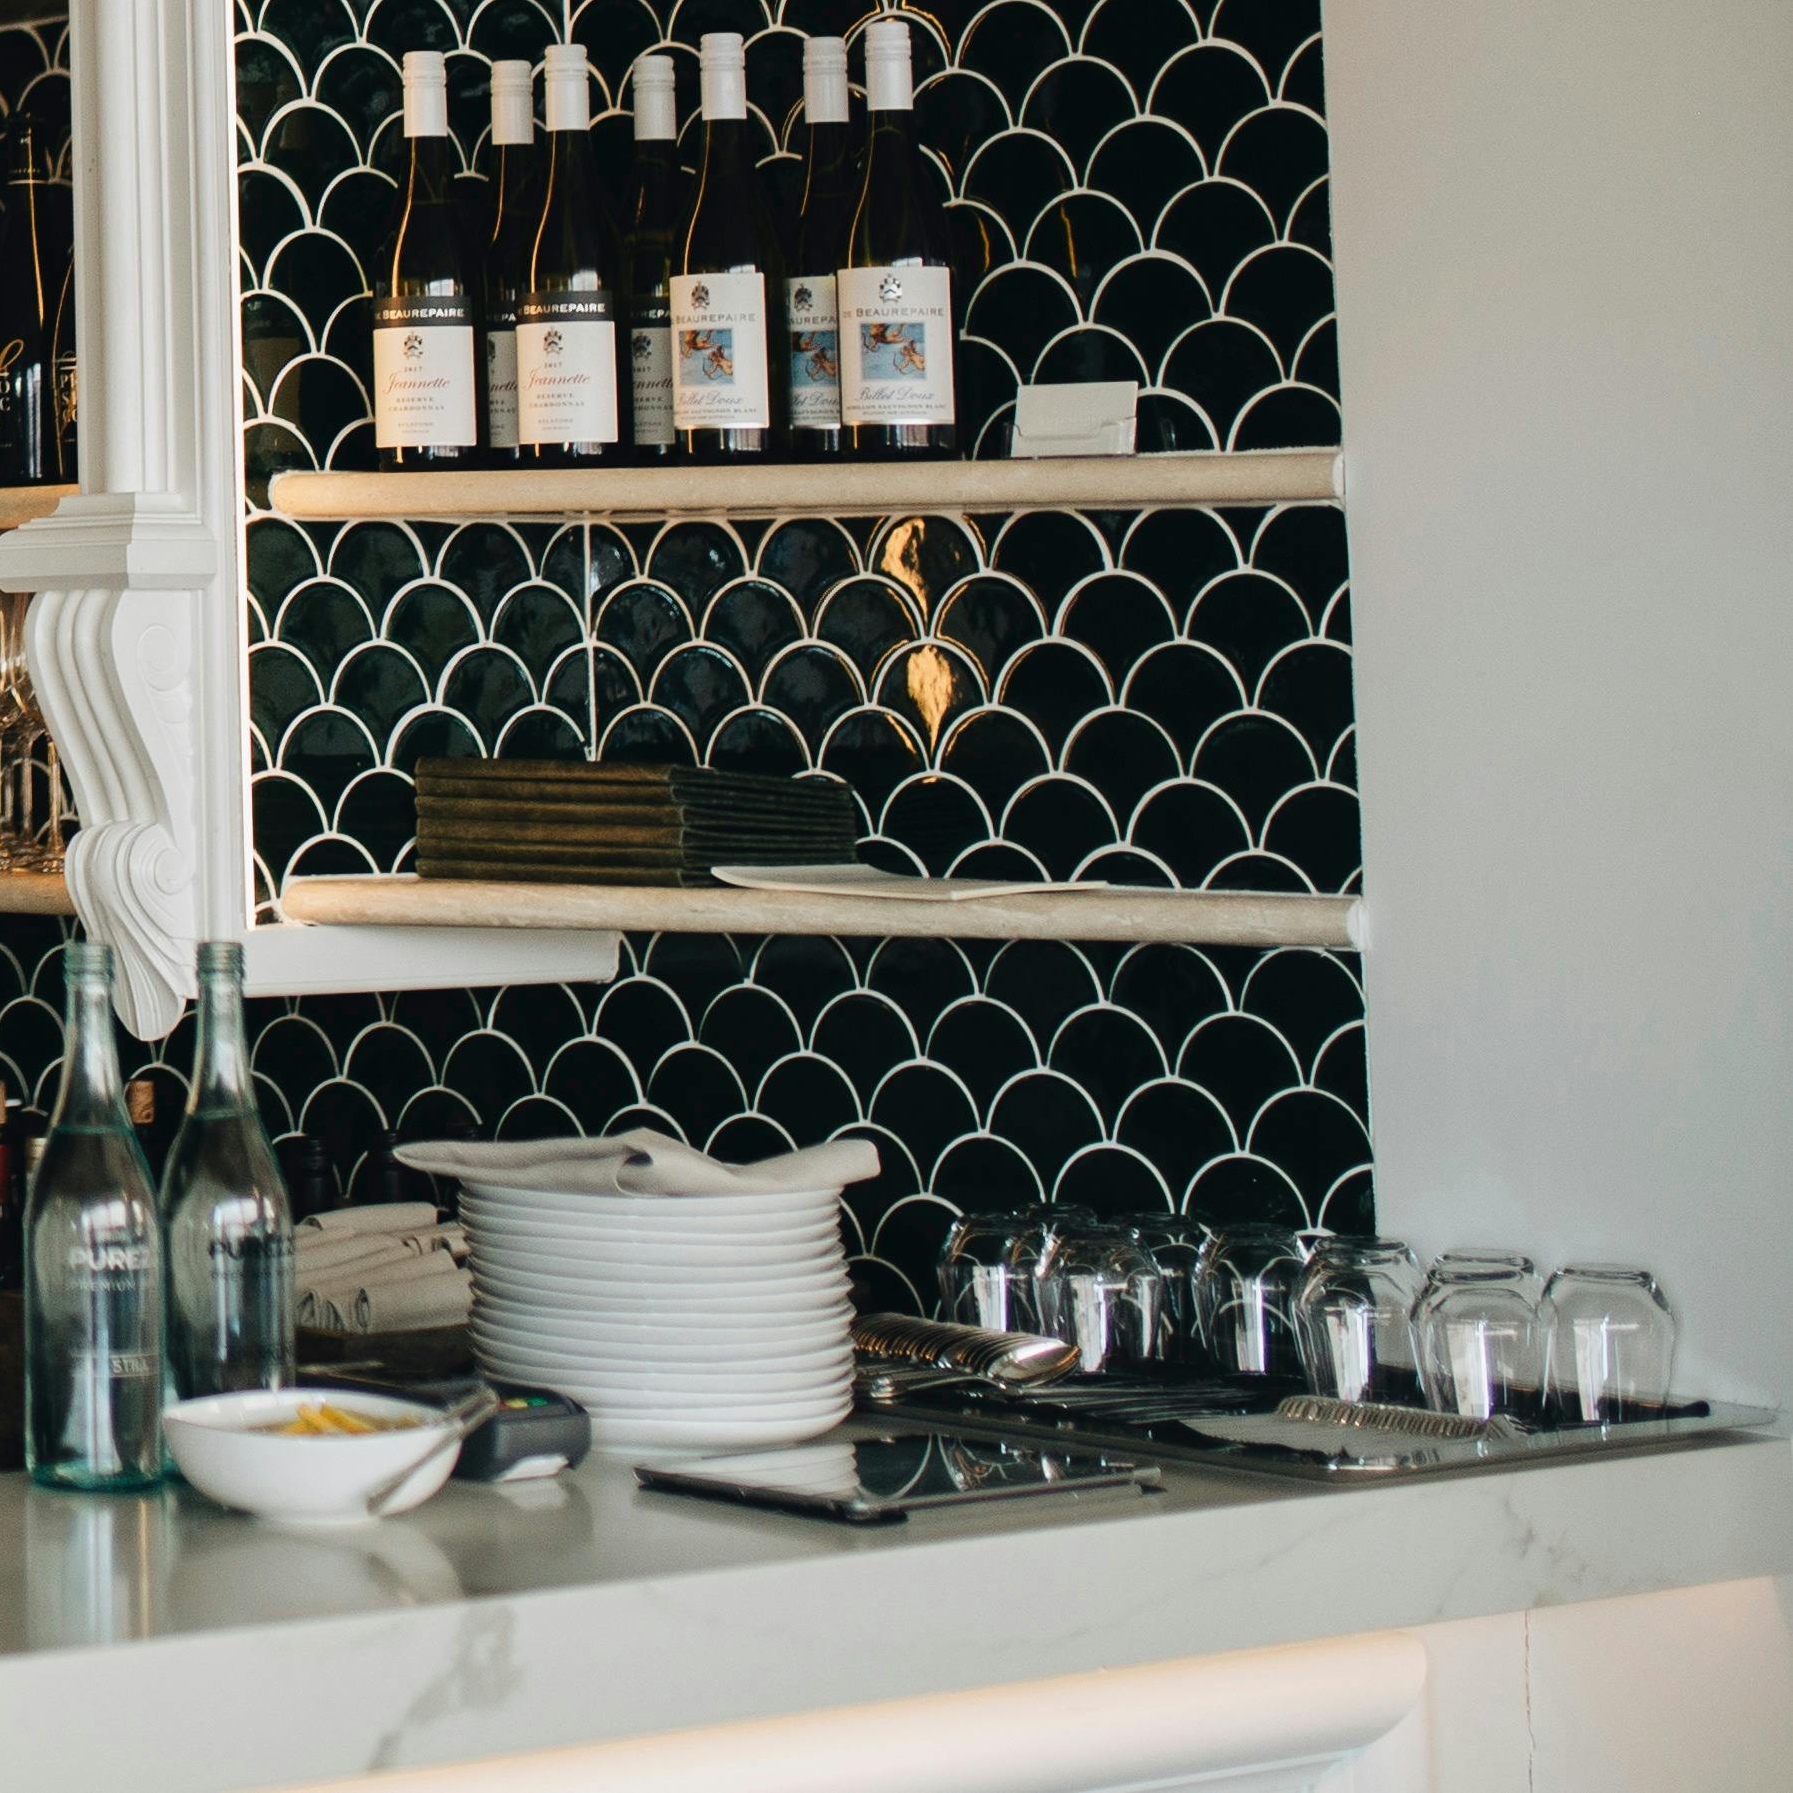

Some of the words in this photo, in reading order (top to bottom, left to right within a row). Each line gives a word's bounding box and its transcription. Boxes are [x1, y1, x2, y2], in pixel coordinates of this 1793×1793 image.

[382, 307, 465, 321] BEAUREPAIRE
[524, 302, 607, 316] BEAUREPAIRE
[856, 307, 944, 318] BEAUREPAIRE
[675, 313, 757, 325] BEAUREPAIRE
[382, 372, 451, 395] Jeannette
[525, 367, 591, 392] Jeannette
[706, 391, 744, 405] Doux
[898, 386, 935, 400] Doux
